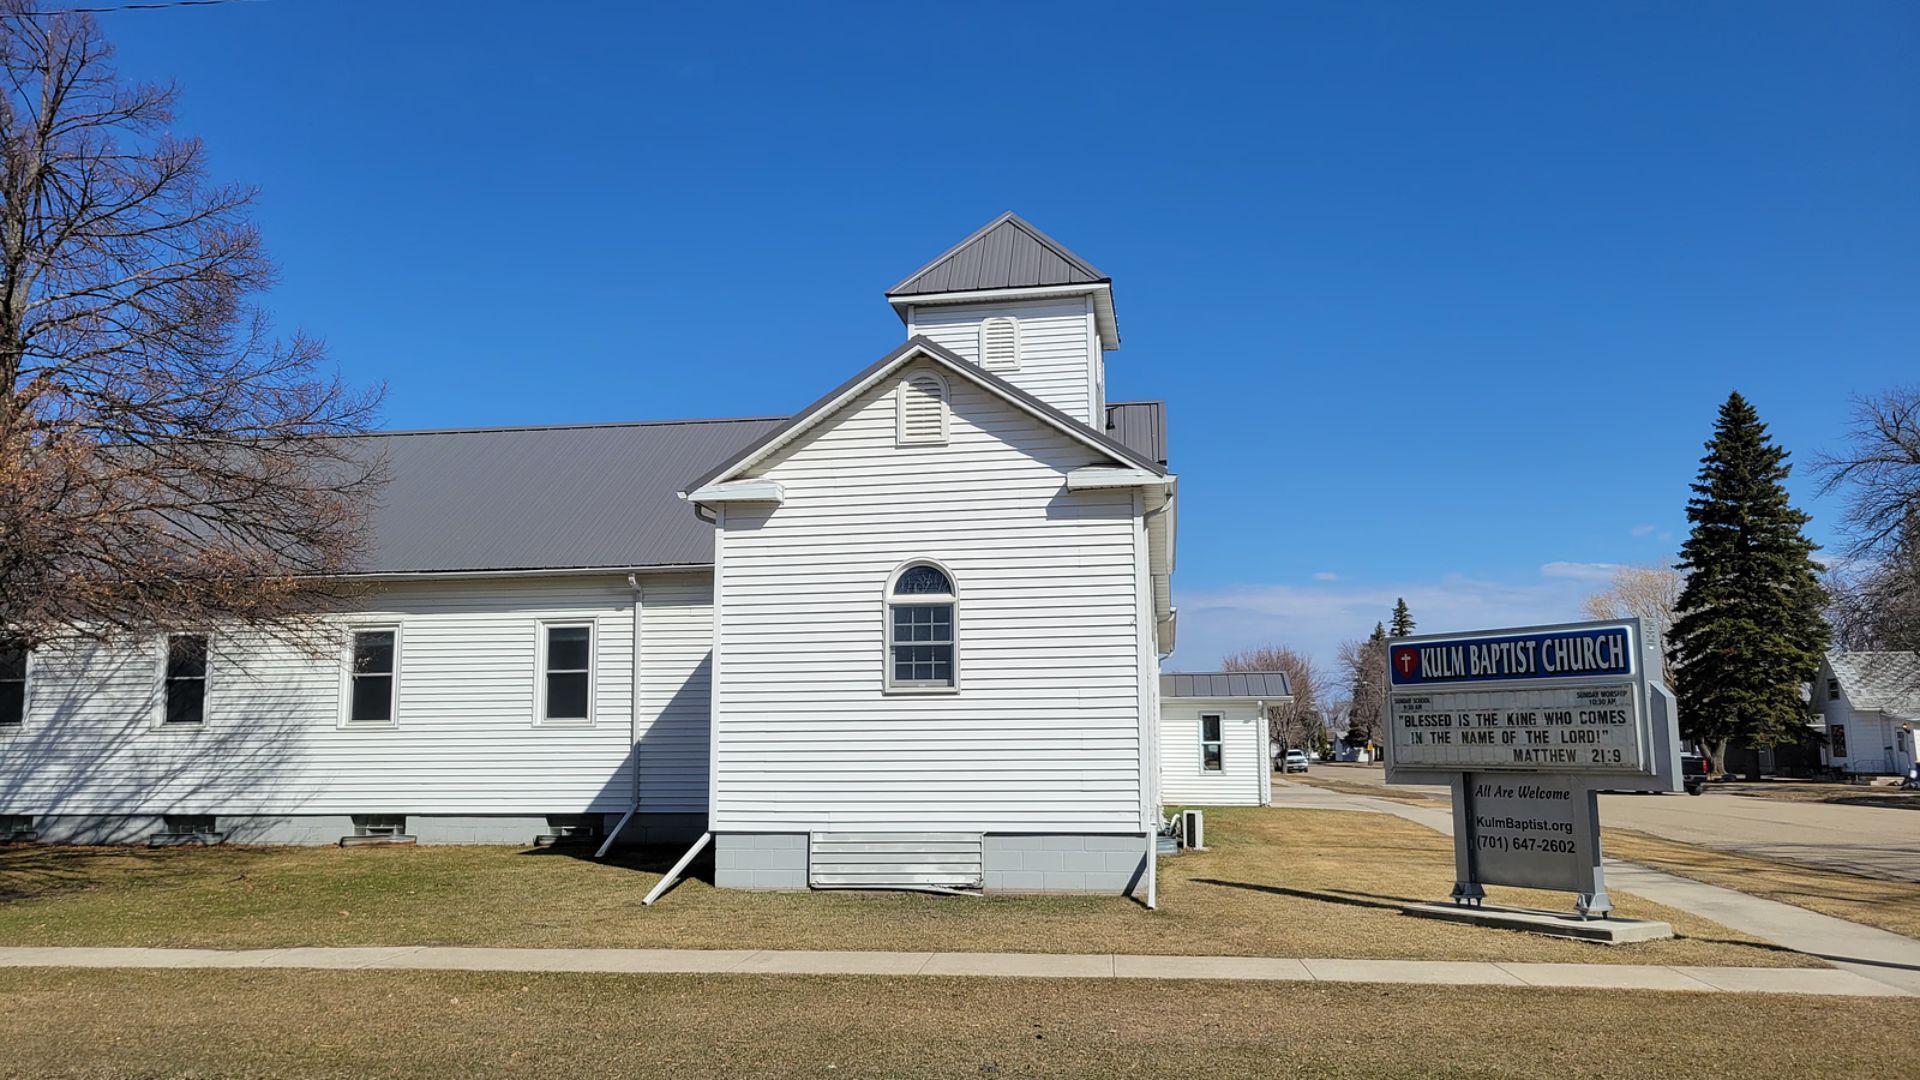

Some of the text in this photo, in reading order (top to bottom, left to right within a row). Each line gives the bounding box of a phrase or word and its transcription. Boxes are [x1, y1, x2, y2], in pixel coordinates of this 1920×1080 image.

[1420, 634, 1625, 678] KULM BAPTIST CHURCH
[1399, 710, 1627, 728] "BLESSED IS THE KING WHO COMES
[1410, 729, 1609, 744] IN THE NAME OF THE LORD!"
[1513, 748, 1621, 762] MATTHEW 21:9
[1475, 784, 1570, 800] All Are Welcome
[1476, 815, 1573, 834] KulmBaptist.org
[1476, 835, 1576, 854] (701) 647-2602
